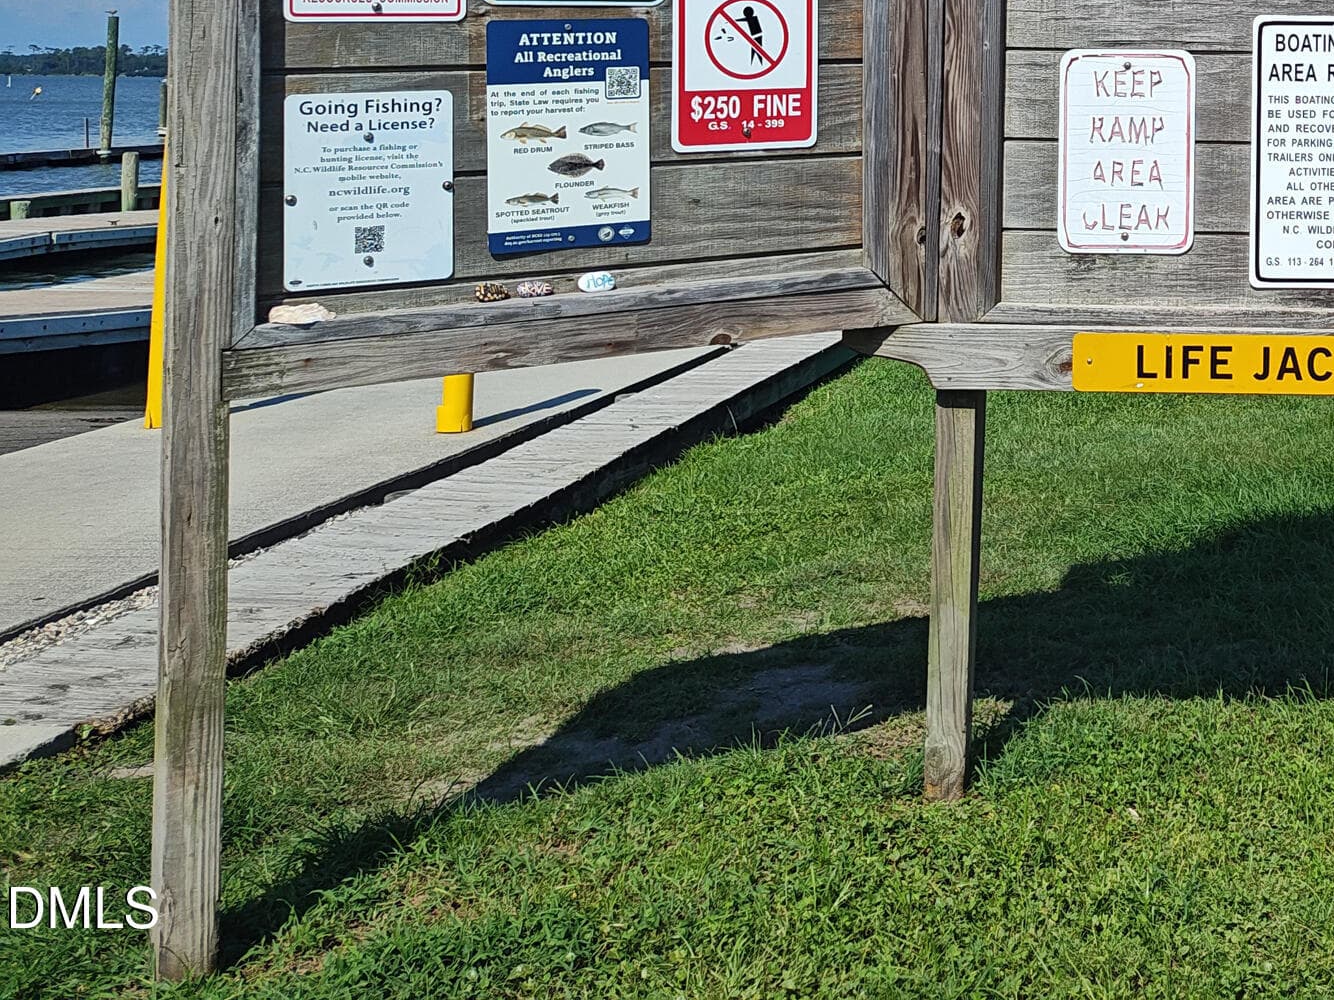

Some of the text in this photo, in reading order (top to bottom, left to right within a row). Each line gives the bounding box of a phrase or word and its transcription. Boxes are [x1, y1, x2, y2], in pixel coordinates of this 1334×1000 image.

[519, 32, 617, 46] ATTENTION
[514, 50, 621, 63] All Recreational
[543, 66, 594, 79] Anglers
[1269, 64, 1317, 81] AREA
[1094, 70, 1163, 97] KEEP
[1269, 96, 1289, 104] THIS
[300, 98, 442, 117] Going Fishing?
[691, 94, 801, 122] $250 FINE
[1268, 110, 1281, 118] BE
[1288, 110, 1316, 118] USED
[307, 118, 435, 132] Need a License?
[1268, 125, 1289, 133] AND
[1268, 139, 1286, 147] FOR
[1292, 139, 1332, 147] PARKING
[1268, 153, 1313, 162] TRAILERS
[1093, 160, 1163, 190] AREA
[329, 185, 410, 197] ncwildlife.org
[1287, 182, 1304, 191] ALL
[593, 202, 629, 210] WEAKFISH
[1267, 197, 1296, 205] AREA
[1301, 197, 1321, 205] ARE
[496, 207, 569, 218] SPOTTED SEATROUT
[1267, 211, 1329, 220] OTHERWISE
[1136, 345, 1232, 380] LIFE
